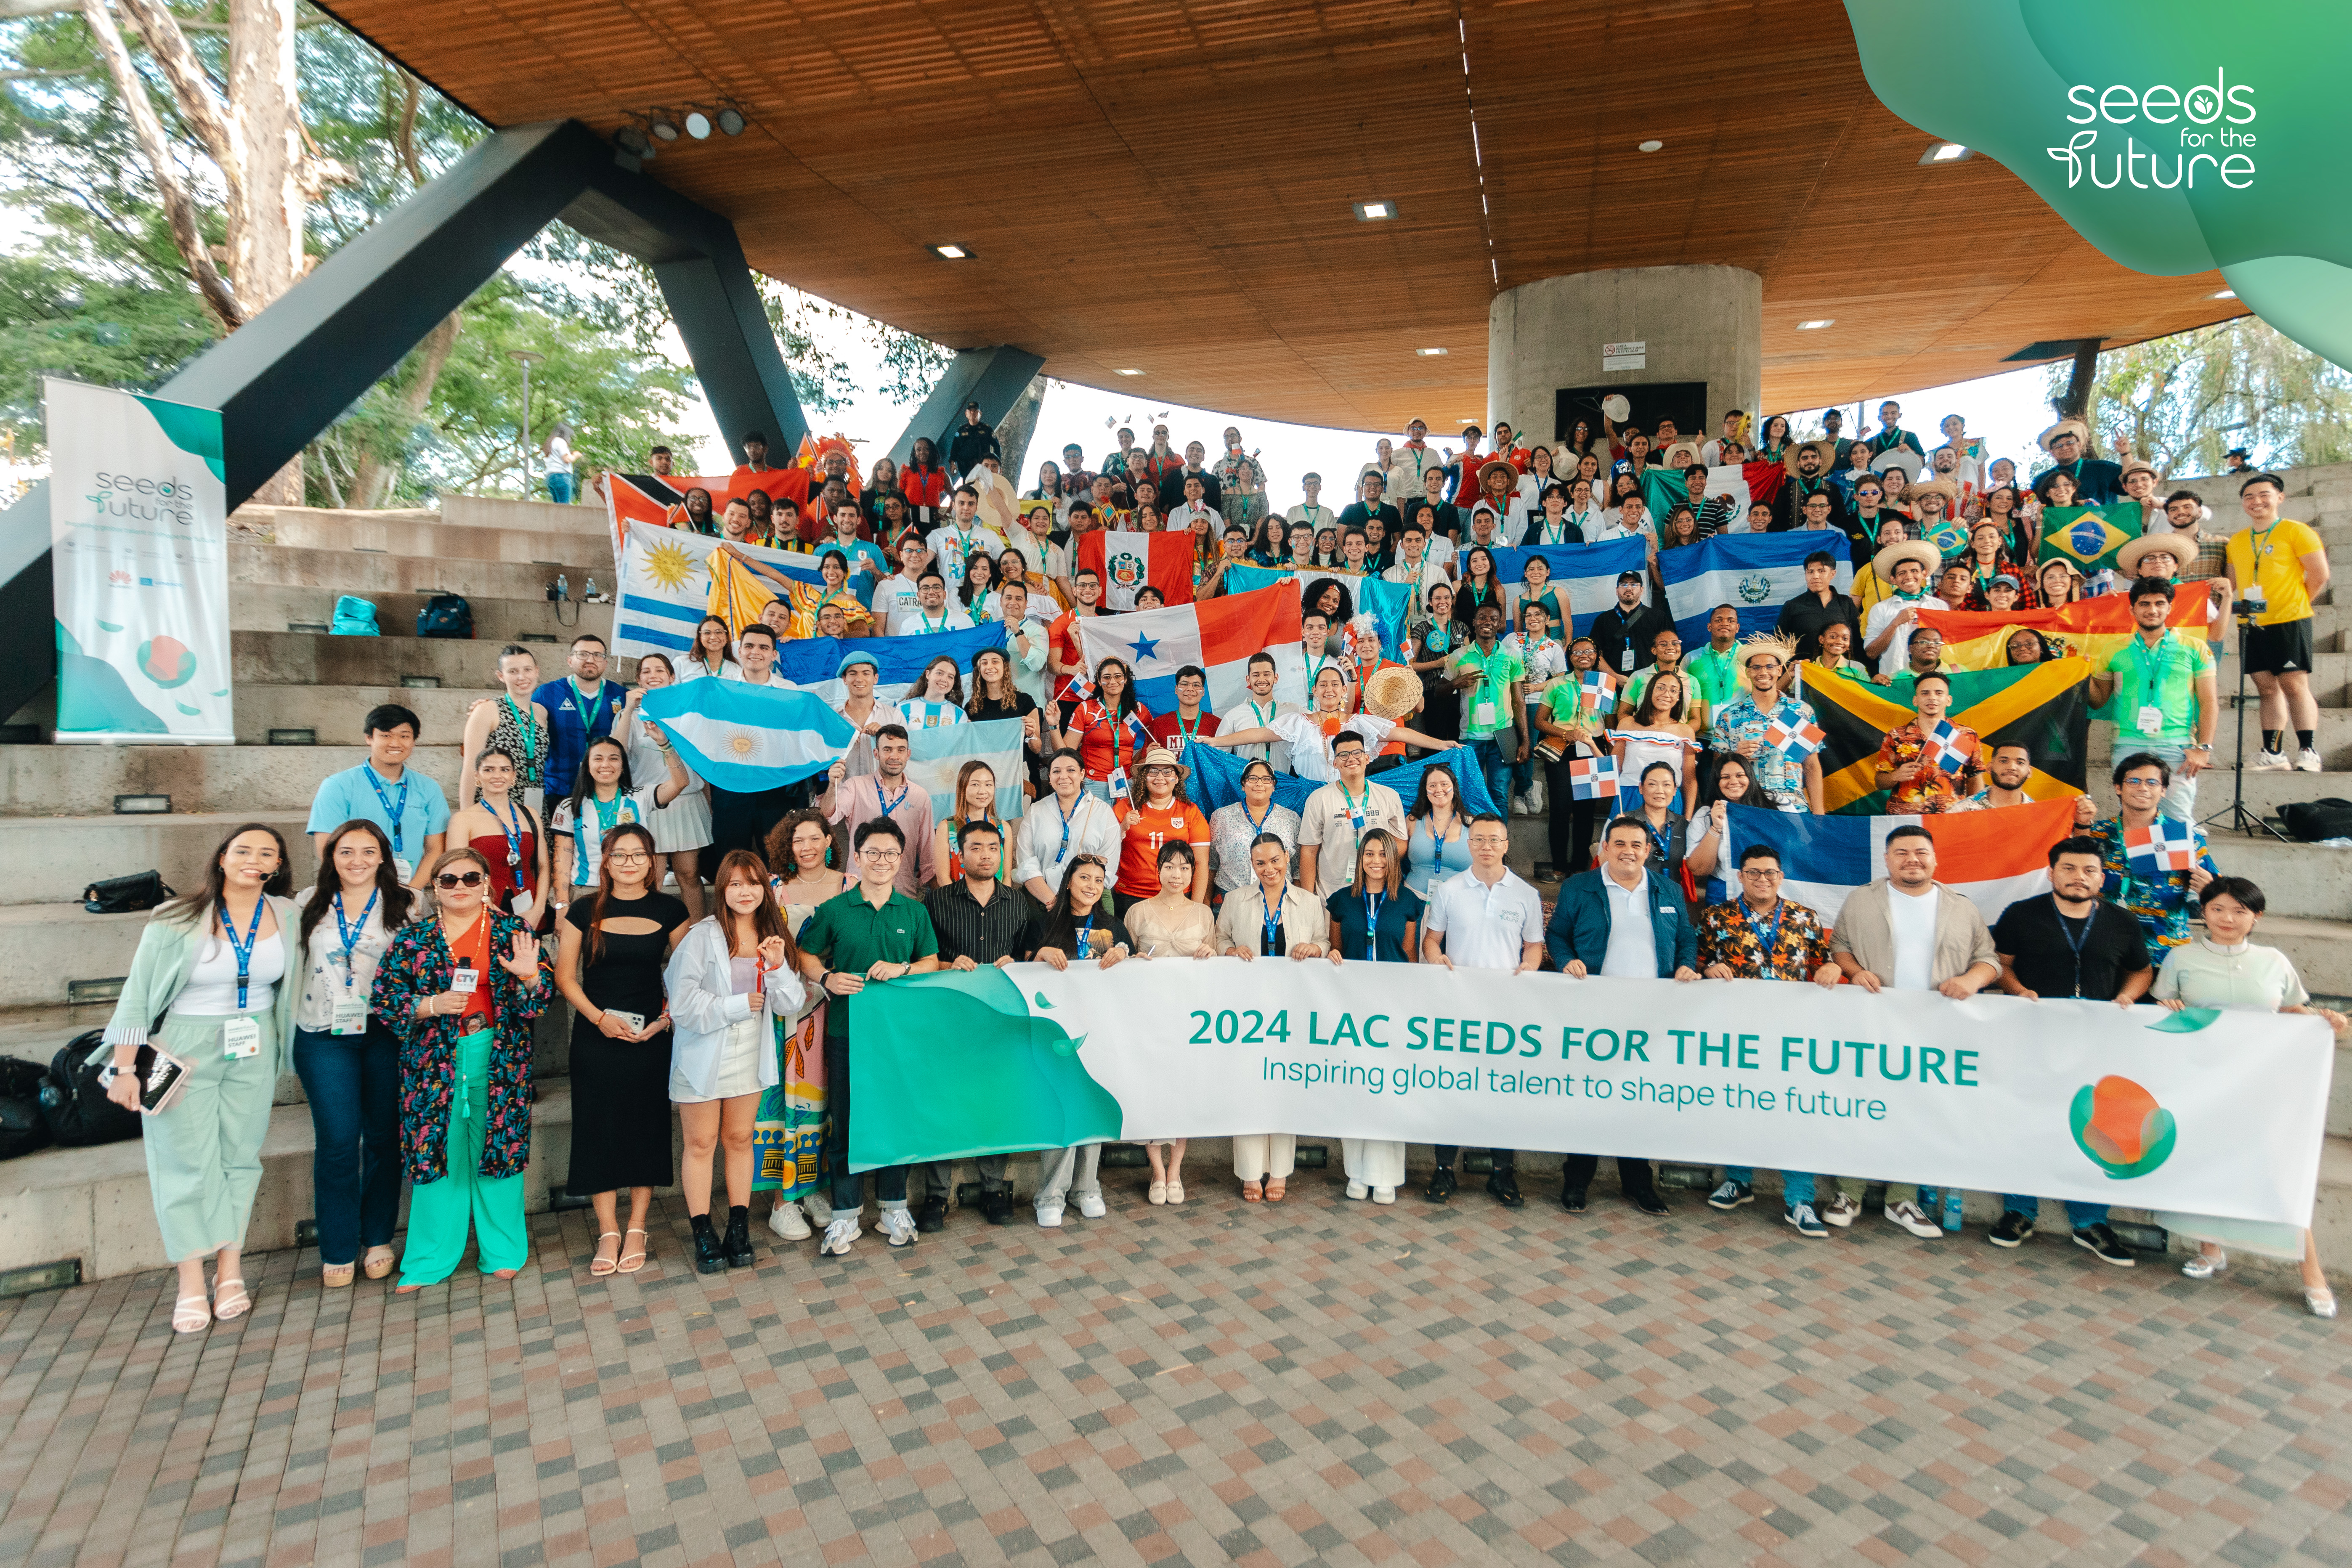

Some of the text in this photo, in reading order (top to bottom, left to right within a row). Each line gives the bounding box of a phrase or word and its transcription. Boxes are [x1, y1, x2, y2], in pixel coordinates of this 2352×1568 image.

[96, 472, 193, 501] seeds
[1148, 831, 1164, 850] 11
[1501, 909, 1520, 918] seeds
[228, 1034, 256, 1043] HUAWEI
[1189, 1009, 1979, 1087] 2024 LAC SEEDS FOR THE FUTURE
[1263, 1056, 1887, 1120] Inspiring global talent to shape the future
